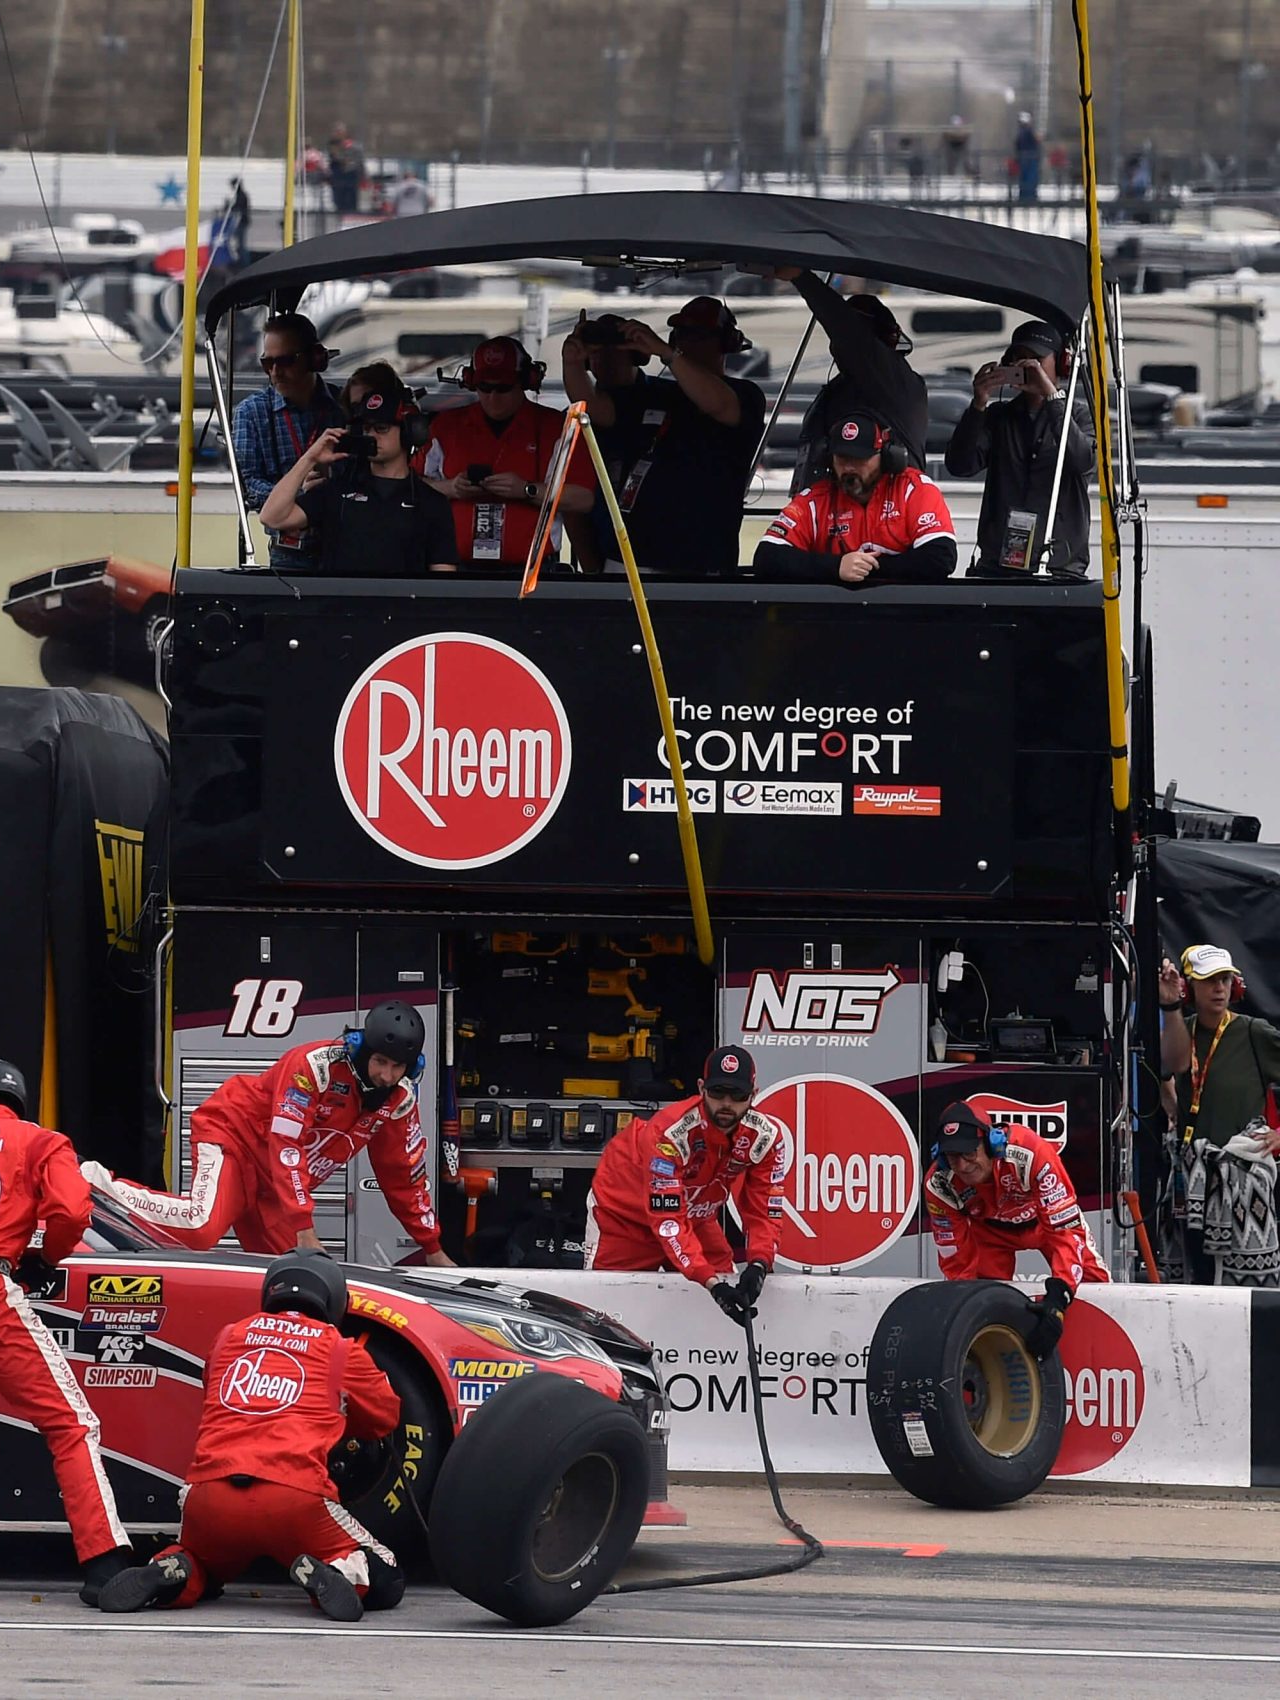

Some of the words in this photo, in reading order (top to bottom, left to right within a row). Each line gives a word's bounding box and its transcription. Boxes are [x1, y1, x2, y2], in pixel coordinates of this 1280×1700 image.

[668, 697, 712, 721] The
[721, 704, 775, 722] new
[784, 699, 877, 729] degree
[887, 701, 915, 725] of
[367, 644, 552, 828] Rheem
[657, 730, 913, 775] COMFORT
[761, 785, 836, 804] Eemax
[860, 788, 918, 807] Raypak
[786, 804, 809, 813] Solutions
[226, 979, 303, 1036] 18
[745, 970, 899, 1031] NOS
[742, 1034, 813, 1047] ENERGY
[816, 1035, 871, 1048] DRINK
[442, 1140, 457, 1177] adidas
[200, 1160, 216, 1181] The
[651, 1195, 661, 1208] 18
[664, 1195, 679, 1208] RC4
[89, 1294, 134, 1303] MECHANIX
[135, 1295, 161, 1304] WEAR
[90, 1308, 158, 1323] Duralast
[350, 1295, 409, 1329] YEAR
[98, 1335, 144, 1350] K&
[245, 1332, 309, 1353] RHEEM.COM
[101, 1350, 135, 1362] N
[648, 1341, 679, 1364] he
[688, 1349, 739, 1365] new
[754, 1344, 837, 1372] degree
[845, 1346, 871, 1368] of
[88, 1368, 154, 1386] SIMPSON
[224, 1350, 298, 1404] Rheem
[664, 1373, 868, 1416] OMFORT
[384, 1423, 425, 1515] EAGLE
